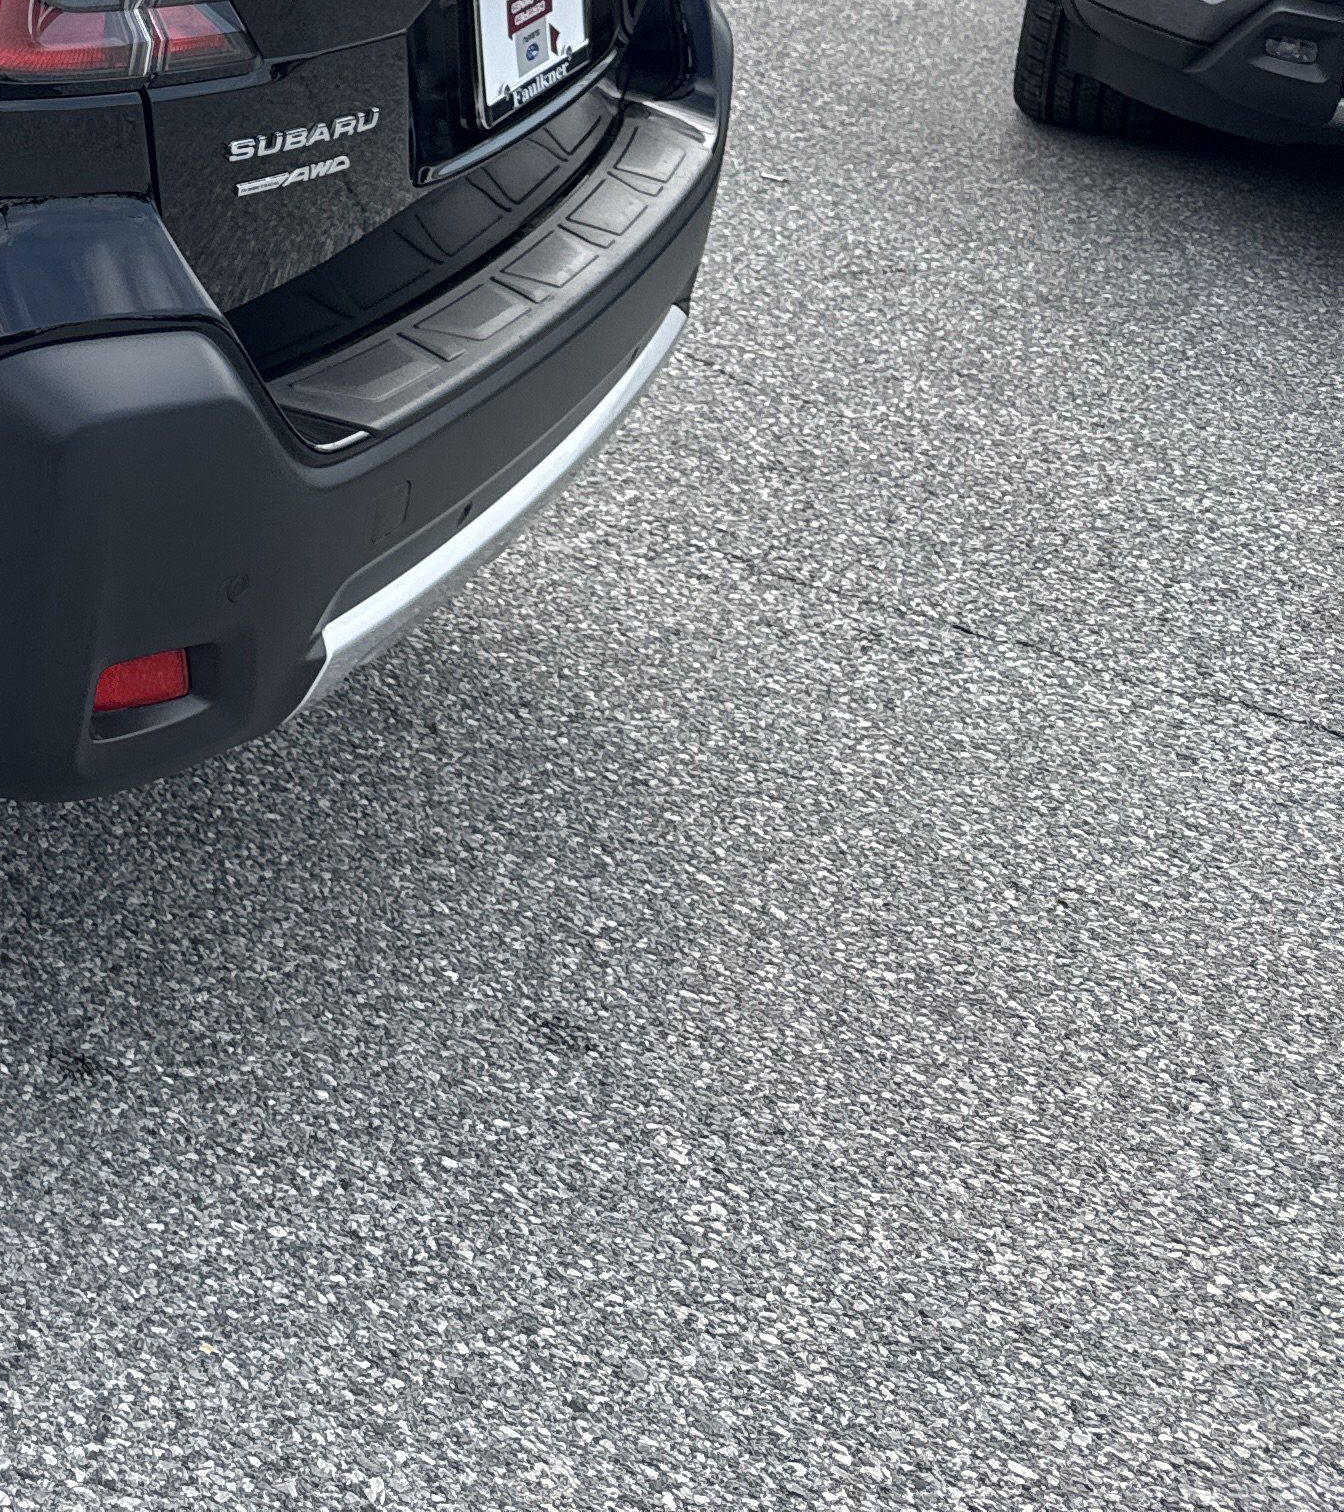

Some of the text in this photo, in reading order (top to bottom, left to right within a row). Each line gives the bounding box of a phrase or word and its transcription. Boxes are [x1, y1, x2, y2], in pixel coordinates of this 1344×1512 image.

[513, 62, 569, 107] Faulkner
[228, 107, 380, 163] SUBARU
[281, 155, 351, 188] AWD
